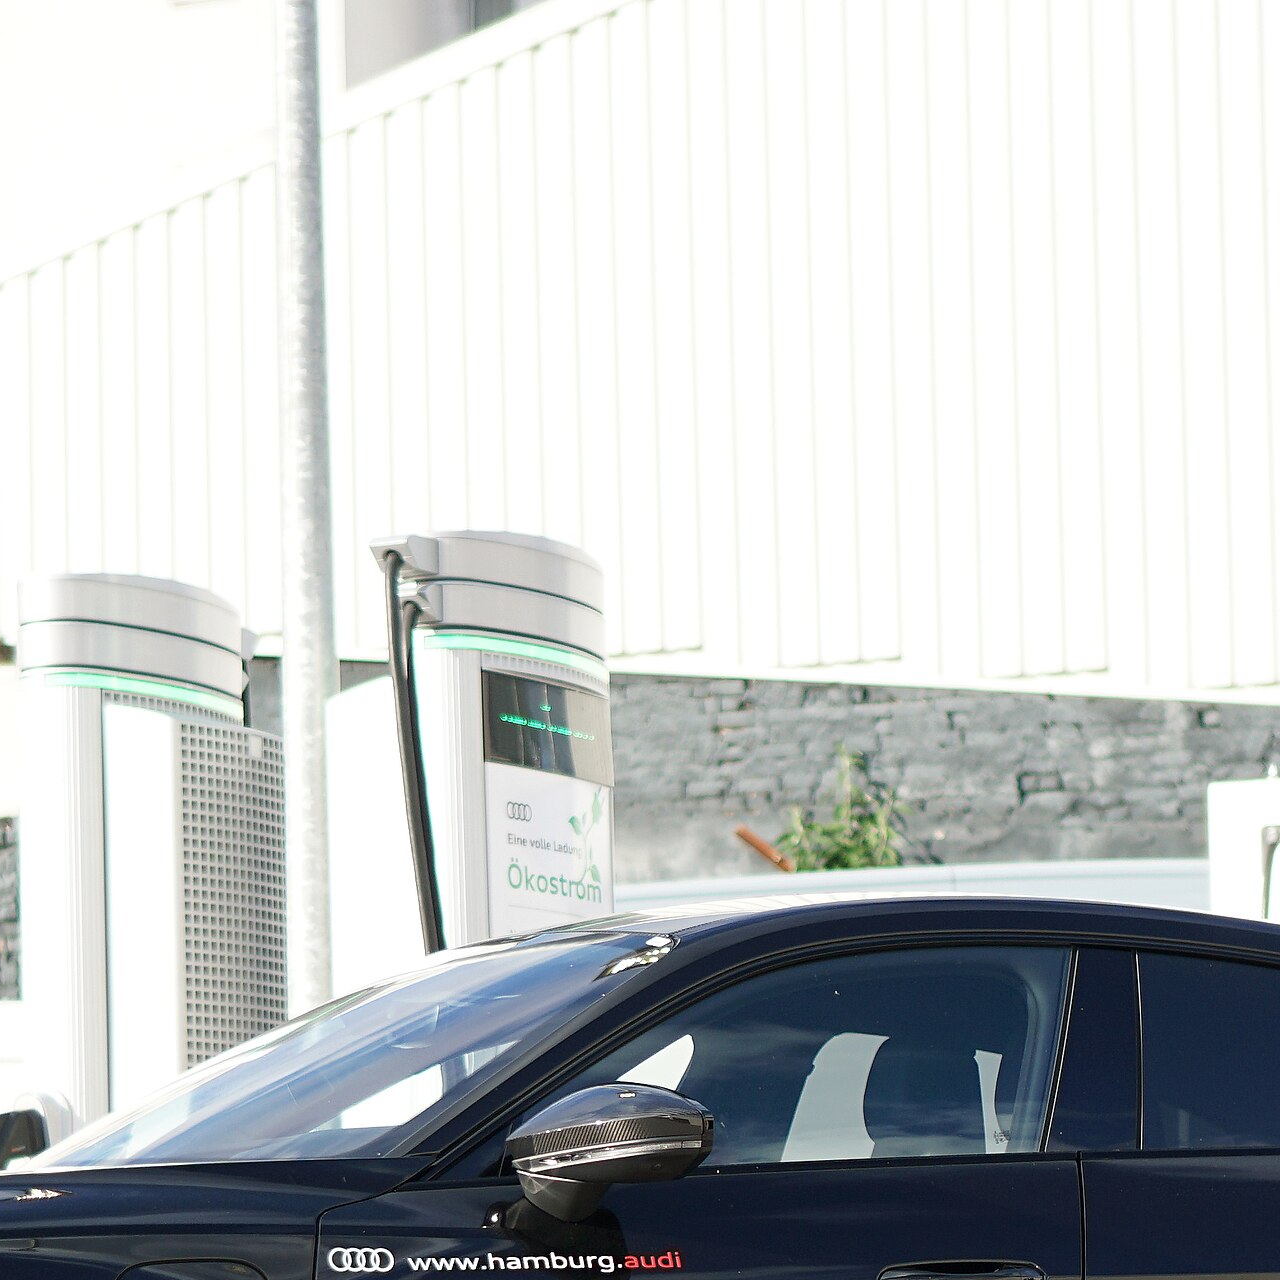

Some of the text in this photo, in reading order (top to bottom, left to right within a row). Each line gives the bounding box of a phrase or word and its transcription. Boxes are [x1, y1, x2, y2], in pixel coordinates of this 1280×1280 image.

[507, 833, 528, 847] Eine
[529, 838, 552, 851] volle
[507, 857, 602, 904] Ökostrom
[407, 1251, 682, 1273] www.hamburg.audi
